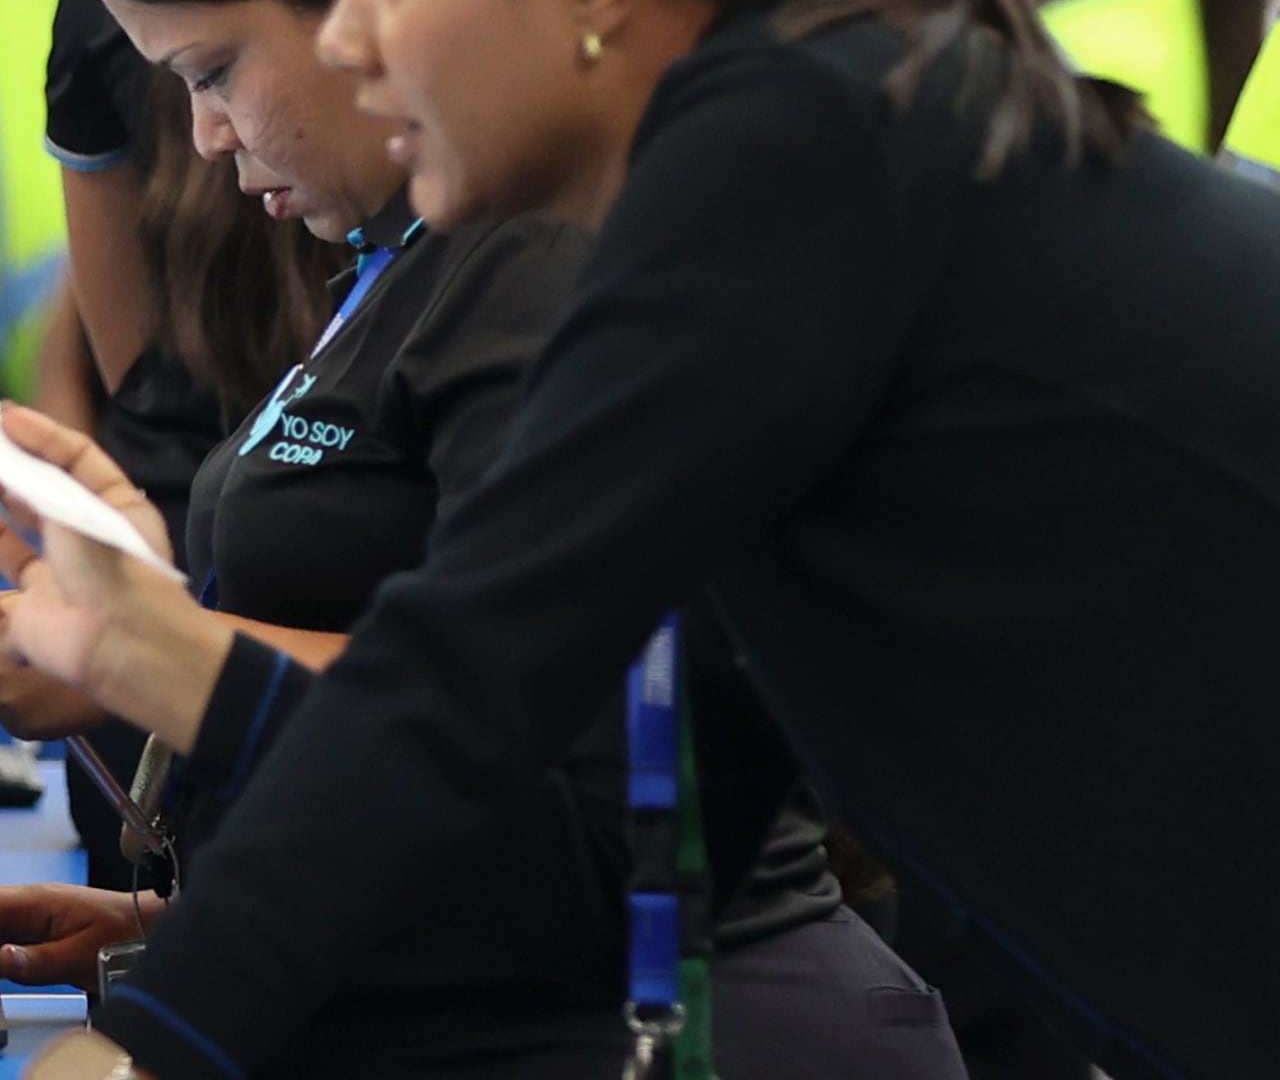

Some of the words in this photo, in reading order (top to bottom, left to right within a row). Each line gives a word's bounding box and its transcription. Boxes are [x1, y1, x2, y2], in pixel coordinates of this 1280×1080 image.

[281, 412, 308, 439] YO
[309, 421, 355, 450] SOY
[269, 441, 323, 465] COPA
